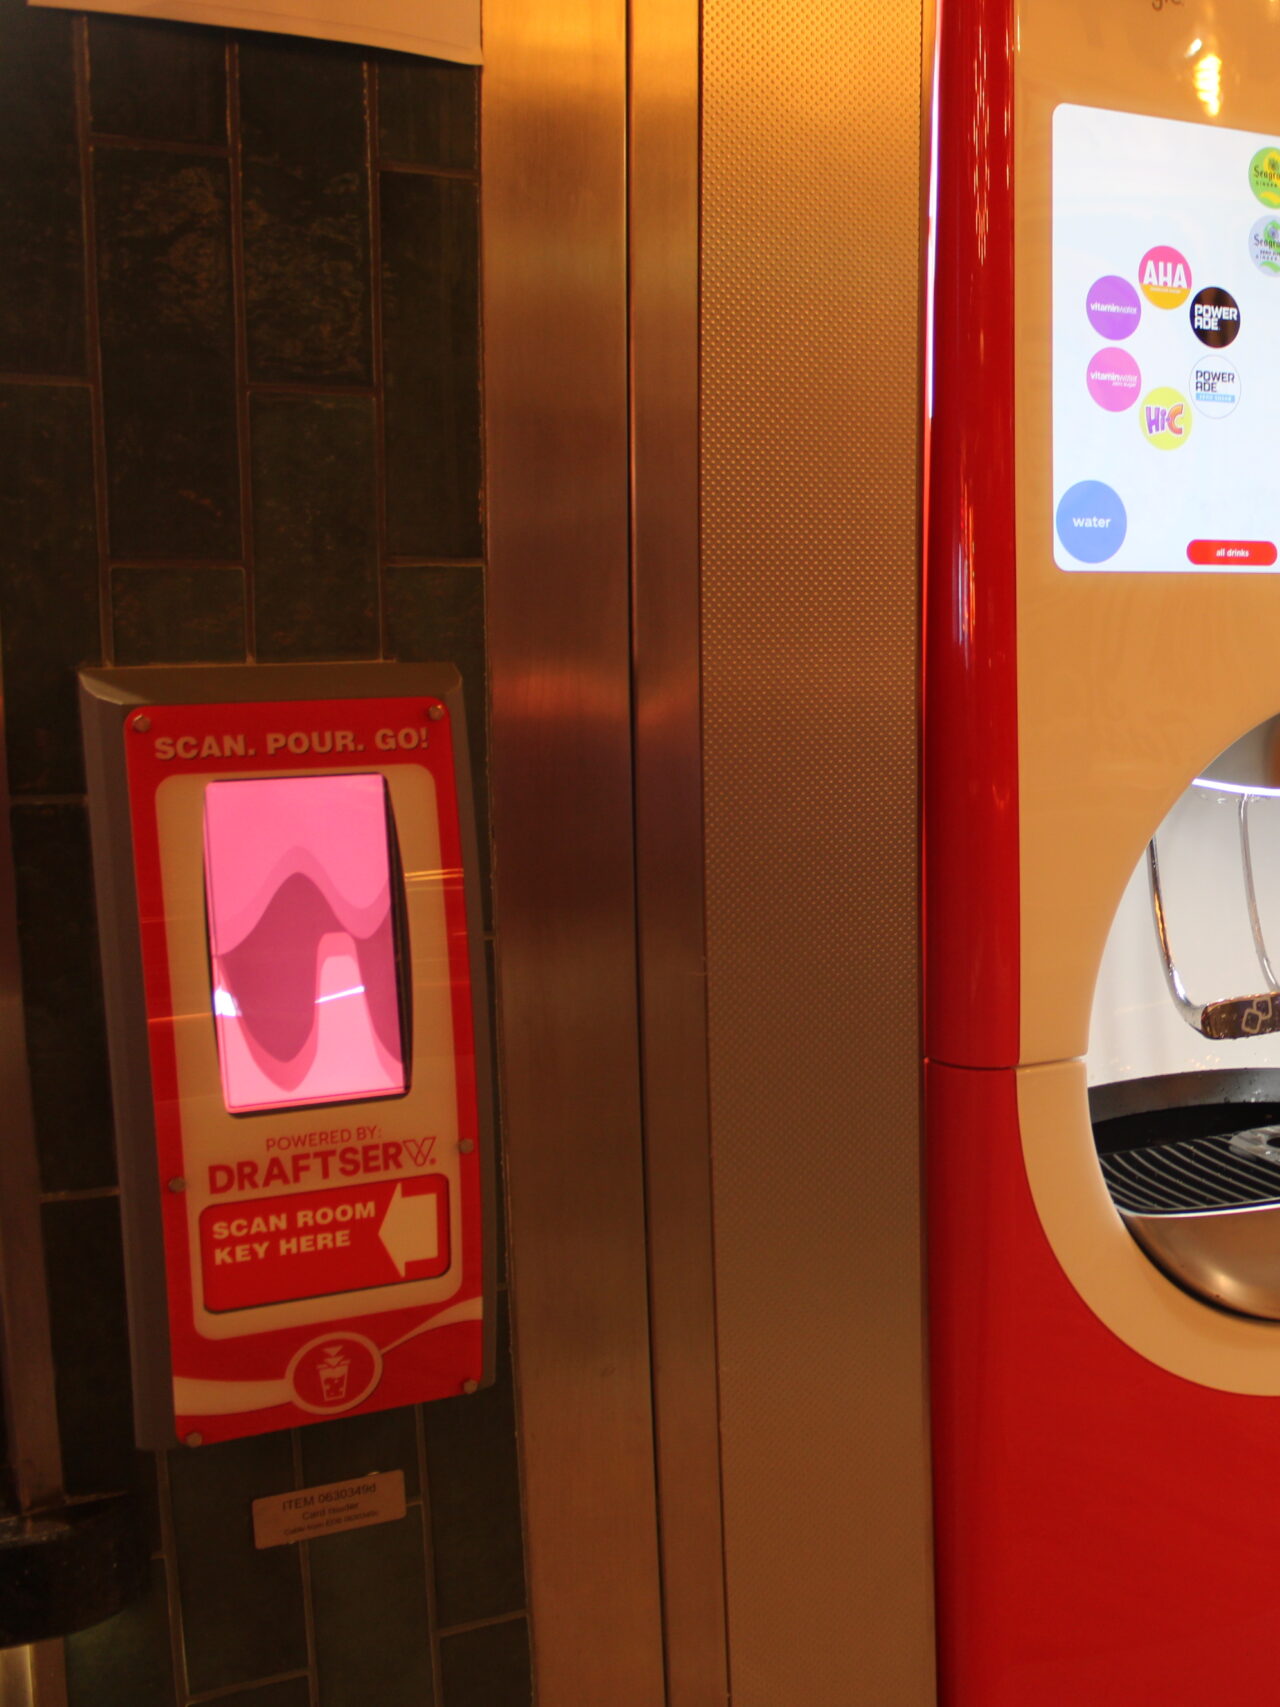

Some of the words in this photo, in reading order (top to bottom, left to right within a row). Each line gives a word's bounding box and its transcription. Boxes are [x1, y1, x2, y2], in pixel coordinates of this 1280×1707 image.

[1143, 260, 1187, 288] AHA
[1090, 301, 1137, 314] vitaminwater
[1194, 303, 1237, 320] POWER
[1194, 316, 1219, 331] ADE
[1090, 371, 1137, 382] vitaminwater
[1196, 370, 1235, 383] POWER
[1196, 381, 1217, 392] ADE
[1072, 516, 1111, 528] water
[1215, 548, 1225, 557] all
[1226, 548, 1249, 558] drinks
[154, 734, 256, 761] SCAN.
[266, 729, 365, 755] POUR.
[375, 727, 430, 751] GO!
[265, 1128, 351, 1151] POWERED
[356, 1125, 383, 1141] BY:
[212, 1213, 288, 1240] SCAN
[296, 1201, 376, 1228] ROOM
[214, 1241, 270, 1266] KEY
[279, 1230, 351, 1256] HERE
[281, 1496, 315, 1512] ITEM
